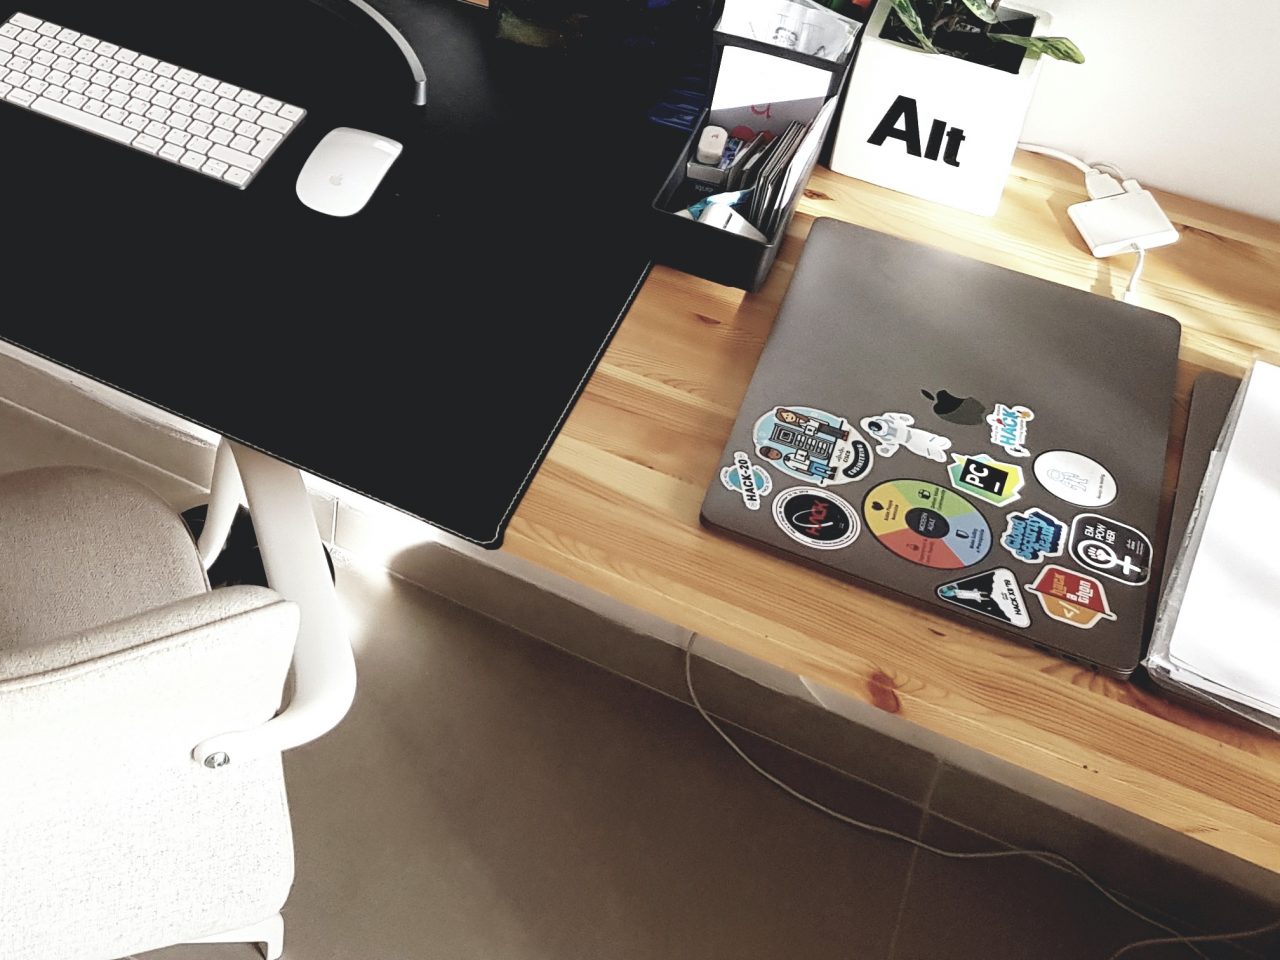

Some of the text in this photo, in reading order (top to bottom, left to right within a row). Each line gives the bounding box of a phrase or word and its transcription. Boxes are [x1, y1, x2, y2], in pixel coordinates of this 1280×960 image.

[867, 95, 965, 167] Alt
[1000, 407, 1019, 446] HACK
[738, 459, 757, 502] HACK-20
[964, 463, 989, 488] PC
[1005, 519, 1026, 549] Cloud
[1016, 514, 1044, 559] Security
[1084, 525, 1095, 537] EM
[1095, 522, 1108, 540] POW
[1106, 530, 1116, 544] HER
[1010, 597, 1022, 616] HACK
